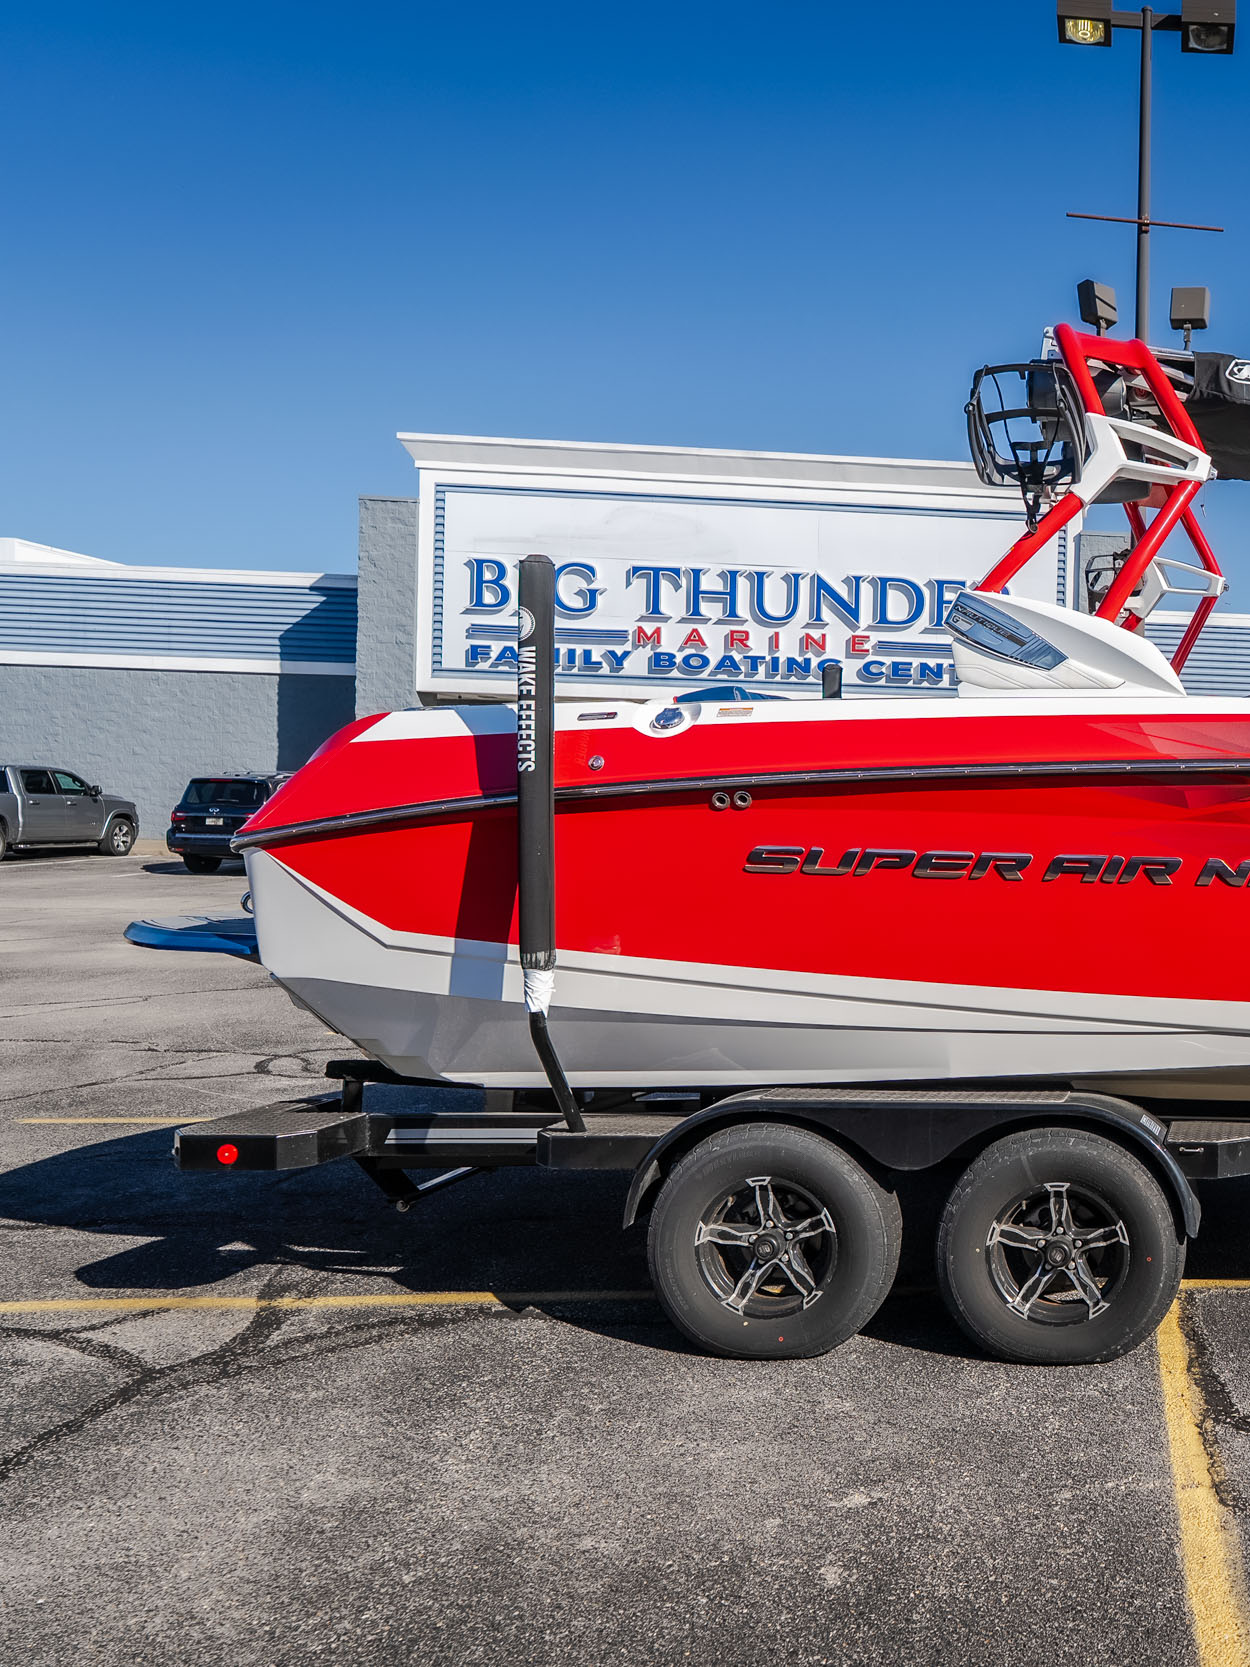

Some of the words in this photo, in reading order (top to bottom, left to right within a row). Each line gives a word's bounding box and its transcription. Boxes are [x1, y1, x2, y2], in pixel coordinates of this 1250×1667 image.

[469, 557, 606, 616] BG
[629, 565, 1010, 630] THUNDE
[635, 625, 871, 654] MARINE
[469, 644, 633, 669] FAILY
[861, 659, 958, 682] CEN
[518, 646, 536, 696] WAKE
[517, 700, 536, 773] EFFECTS
[744, 845, 1034, 882] SUPER
[1041, 854, 1184, 885] AIR
